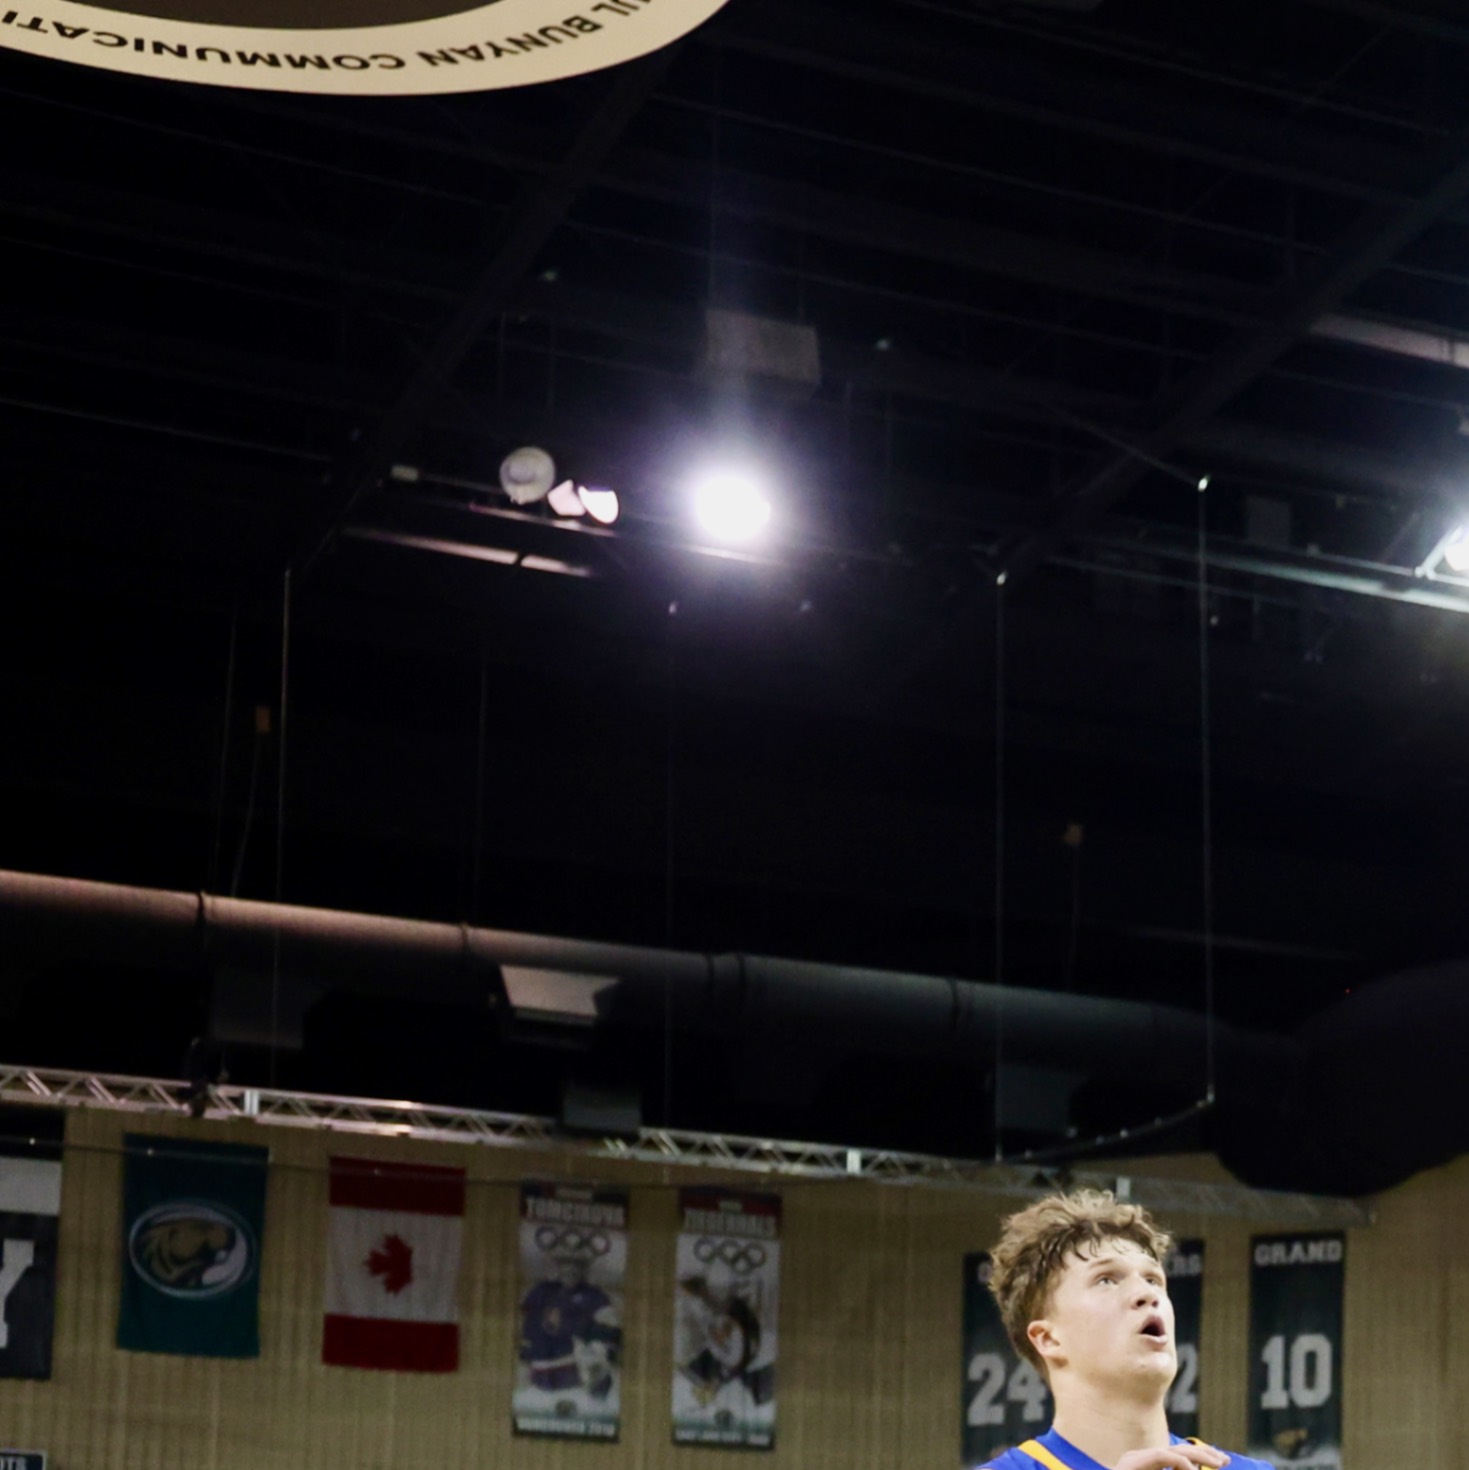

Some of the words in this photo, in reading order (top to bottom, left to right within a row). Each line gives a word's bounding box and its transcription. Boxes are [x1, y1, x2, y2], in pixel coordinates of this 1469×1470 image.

[2, 11, 406, 70] COMMUNICATI
[416, 15, 604, 66] BUNYAN
[1253, 1239, 1343, 1267] GRAND
[966, 1352, 1048, 1427] 24
[1260, 1332, 1334, 1410] 10
